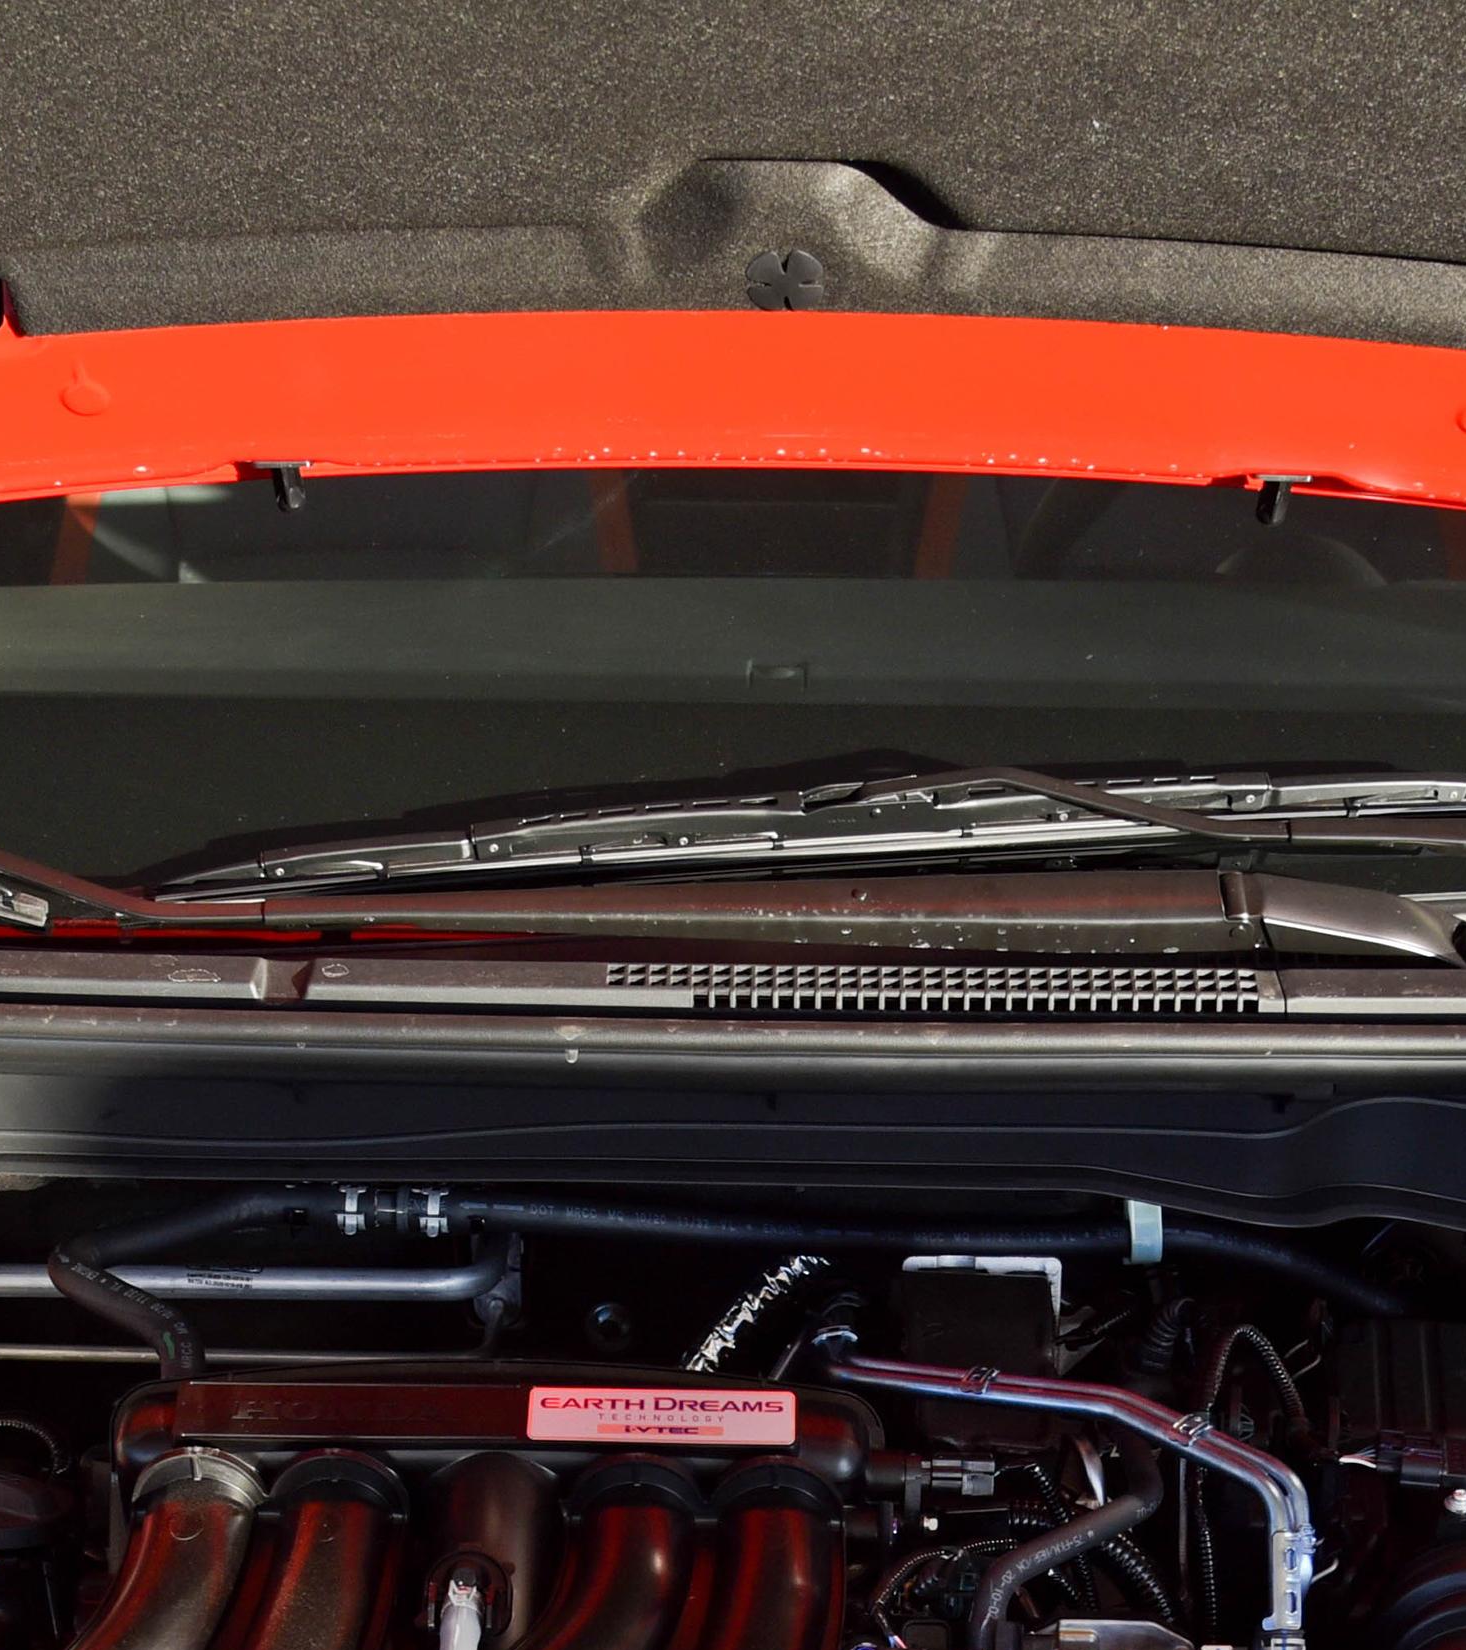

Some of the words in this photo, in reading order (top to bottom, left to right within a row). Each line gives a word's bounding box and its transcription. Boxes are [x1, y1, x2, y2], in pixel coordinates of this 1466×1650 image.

[540, 1397, 645, 1410] EARTH
[654, 1397, 784, 1413] DREAMS
[598, 1412, 725, 1422] TECHNOLOGY
